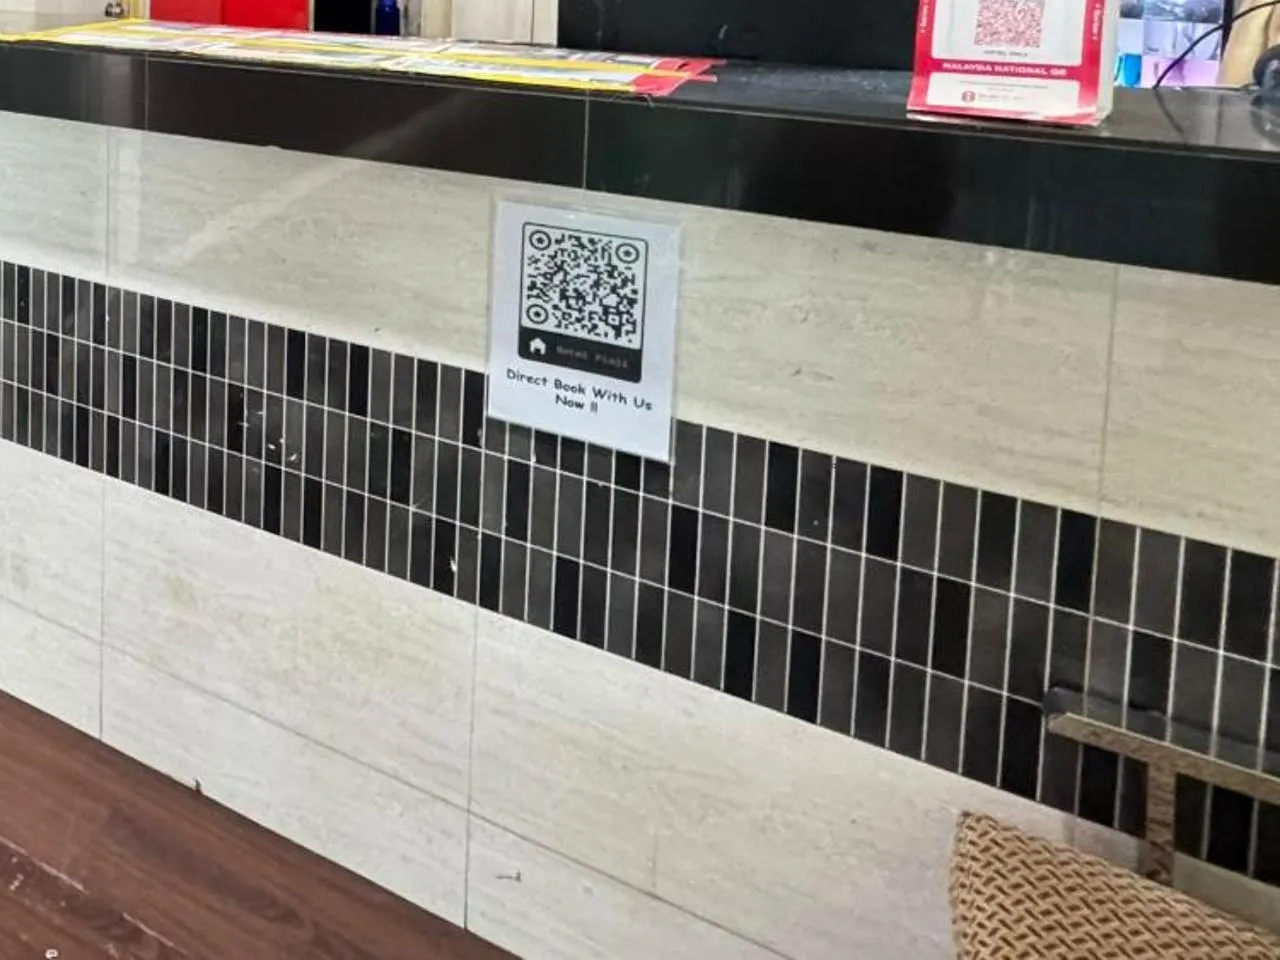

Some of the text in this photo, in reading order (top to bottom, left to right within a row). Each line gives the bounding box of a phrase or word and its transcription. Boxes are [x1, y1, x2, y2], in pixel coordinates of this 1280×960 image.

[942, 62, 992, 72] MALAYSIA
[994, 65, 1047, 75] NATIONAL
[506, 368, 653, 411] Direct Book With Us
[555, 394, 585, 410] Now
